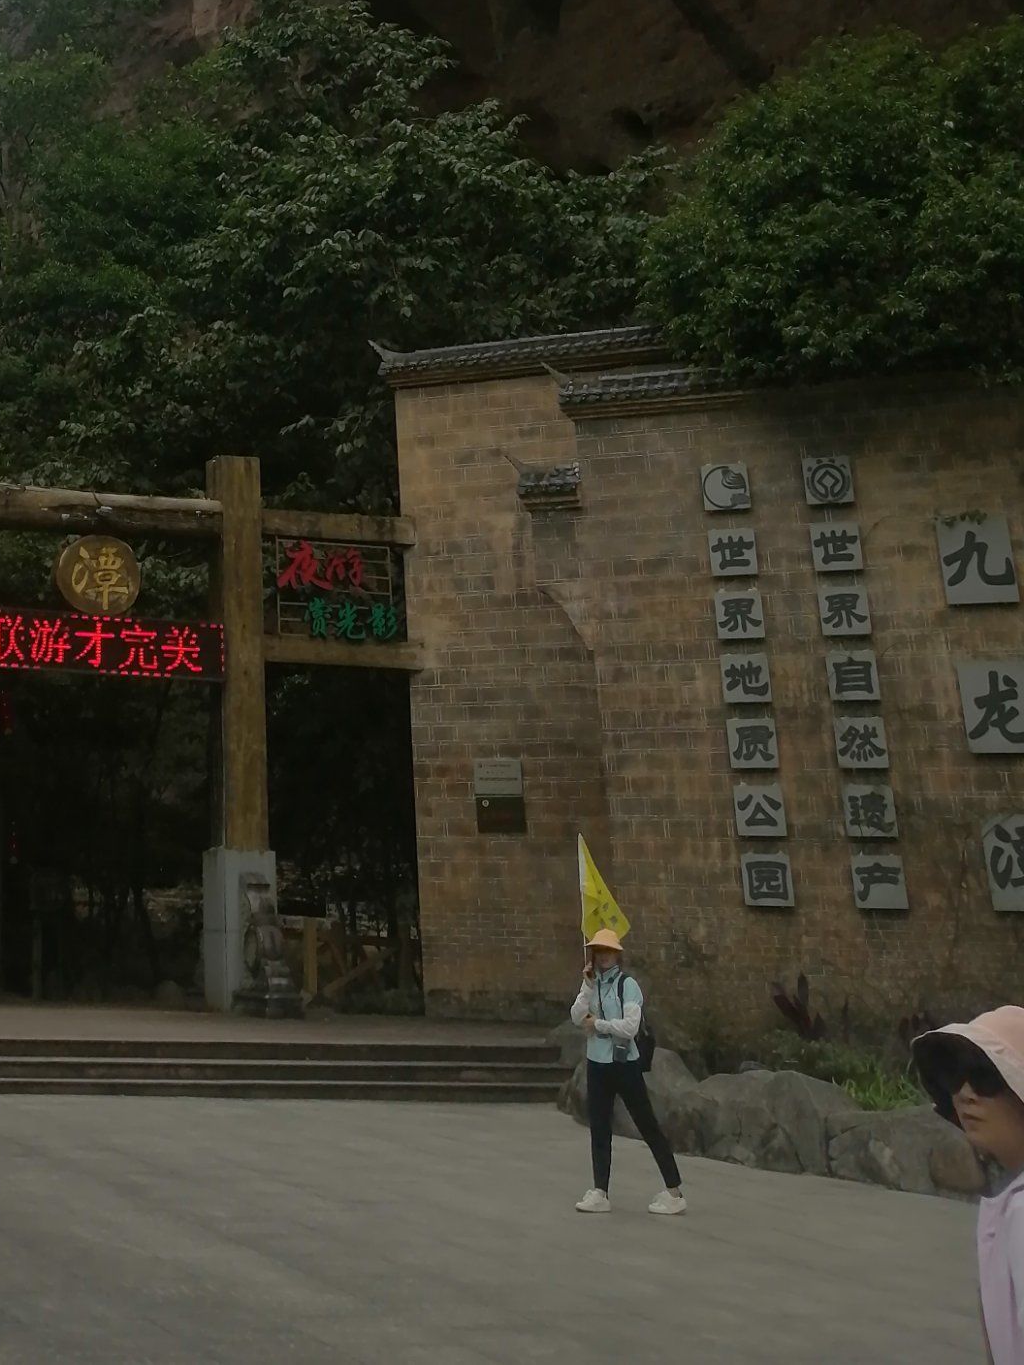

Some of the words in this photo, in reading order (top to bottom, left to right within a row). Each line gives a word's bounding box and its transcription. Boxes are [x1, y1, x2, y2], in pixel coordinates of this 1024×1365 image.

[277, 539, 363, 590] 夜游
[304, 597, 397, 639] 赏光影
[711, 535, 789, 901] 世界地质公园
